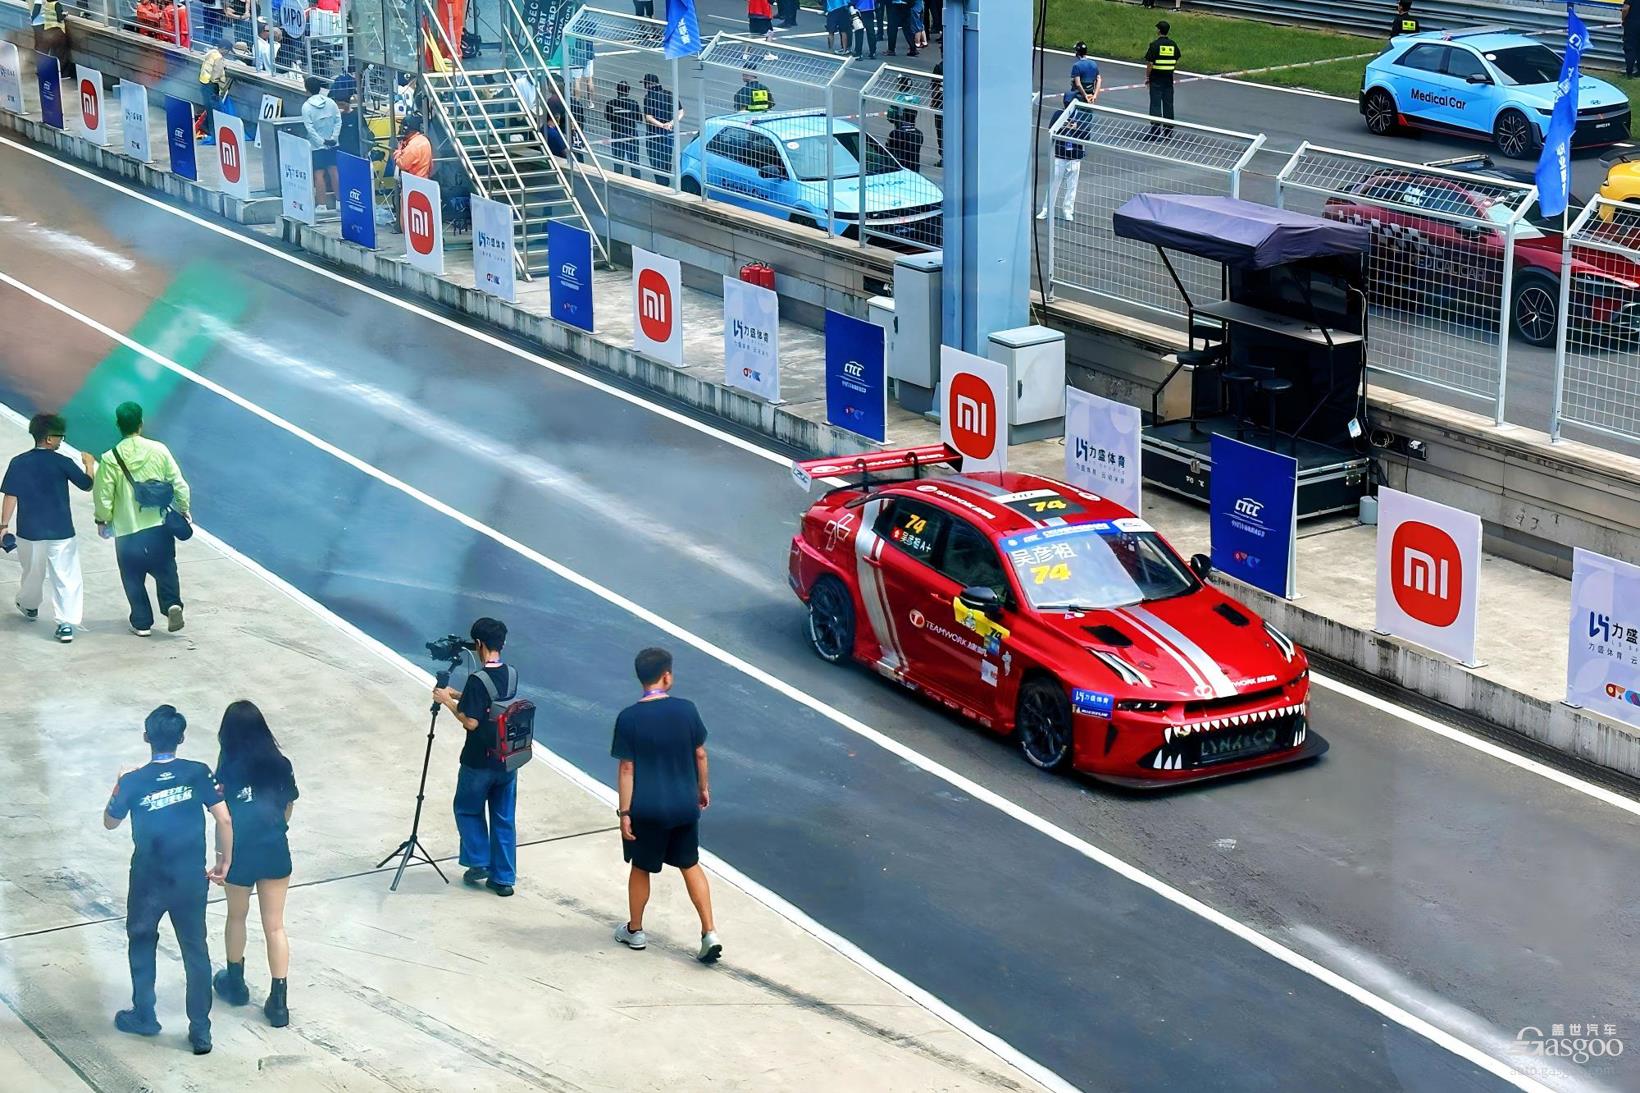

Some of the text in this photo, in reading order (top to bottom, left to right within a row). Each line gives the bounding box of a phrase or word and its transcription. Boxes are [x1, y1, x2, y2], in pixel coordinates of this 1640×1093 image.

[1411, 88, 1467, 110] Medical Car
[844, 362, 862, 377] CTCC
[1089, 445, 1126, 469] 力盛体育
[1028, 499, 1067, 513] 74
[1235, 499, 1261, 517] CTCC
[904, 514, 927, 534] 74
[1009, 542, 1078, 567] 吴彦祖
[1030, 562, 1072, 585] 74
[925, 620, 967, 647] TEAMWORK
